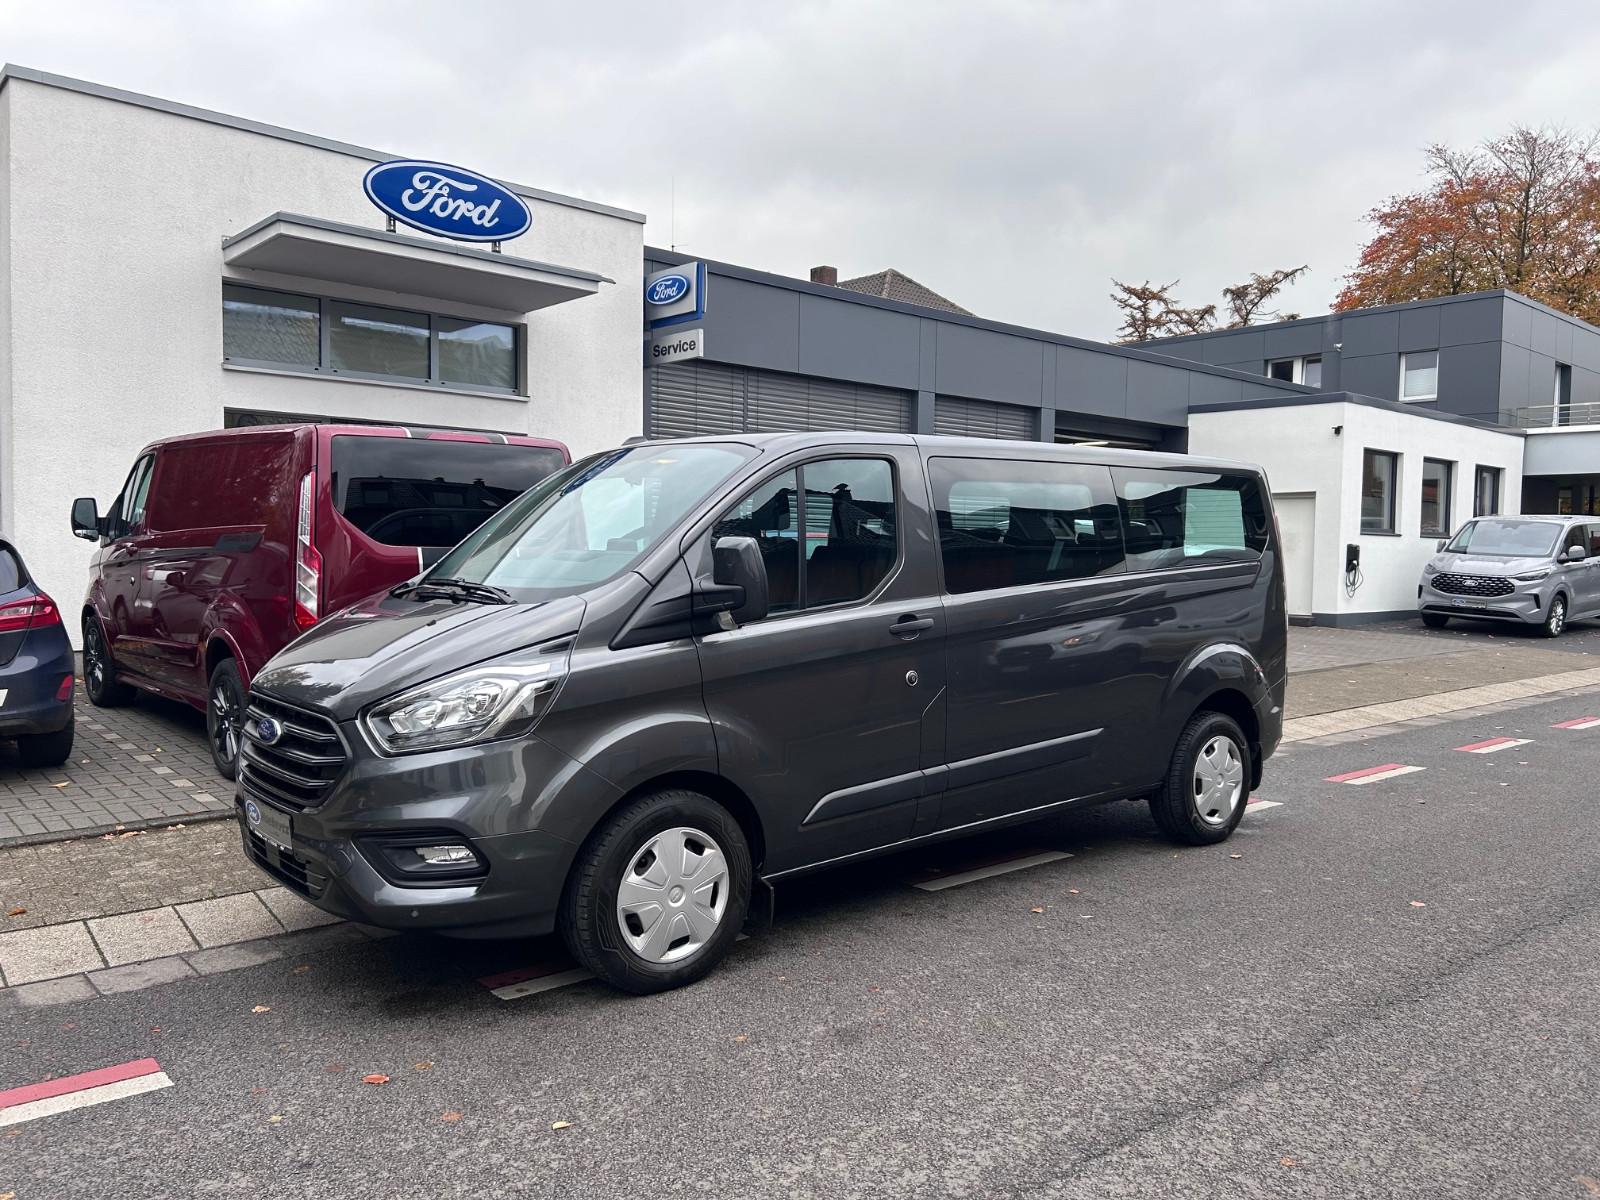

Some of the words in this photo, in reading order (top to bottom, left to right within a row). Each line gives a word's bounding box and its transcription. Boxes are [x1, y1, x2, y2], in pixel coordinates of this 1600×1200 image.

[401, 171, 502, 228] Ford
[653, 279, 679, 301] Ford
[652, 339, 697, 358] Service
